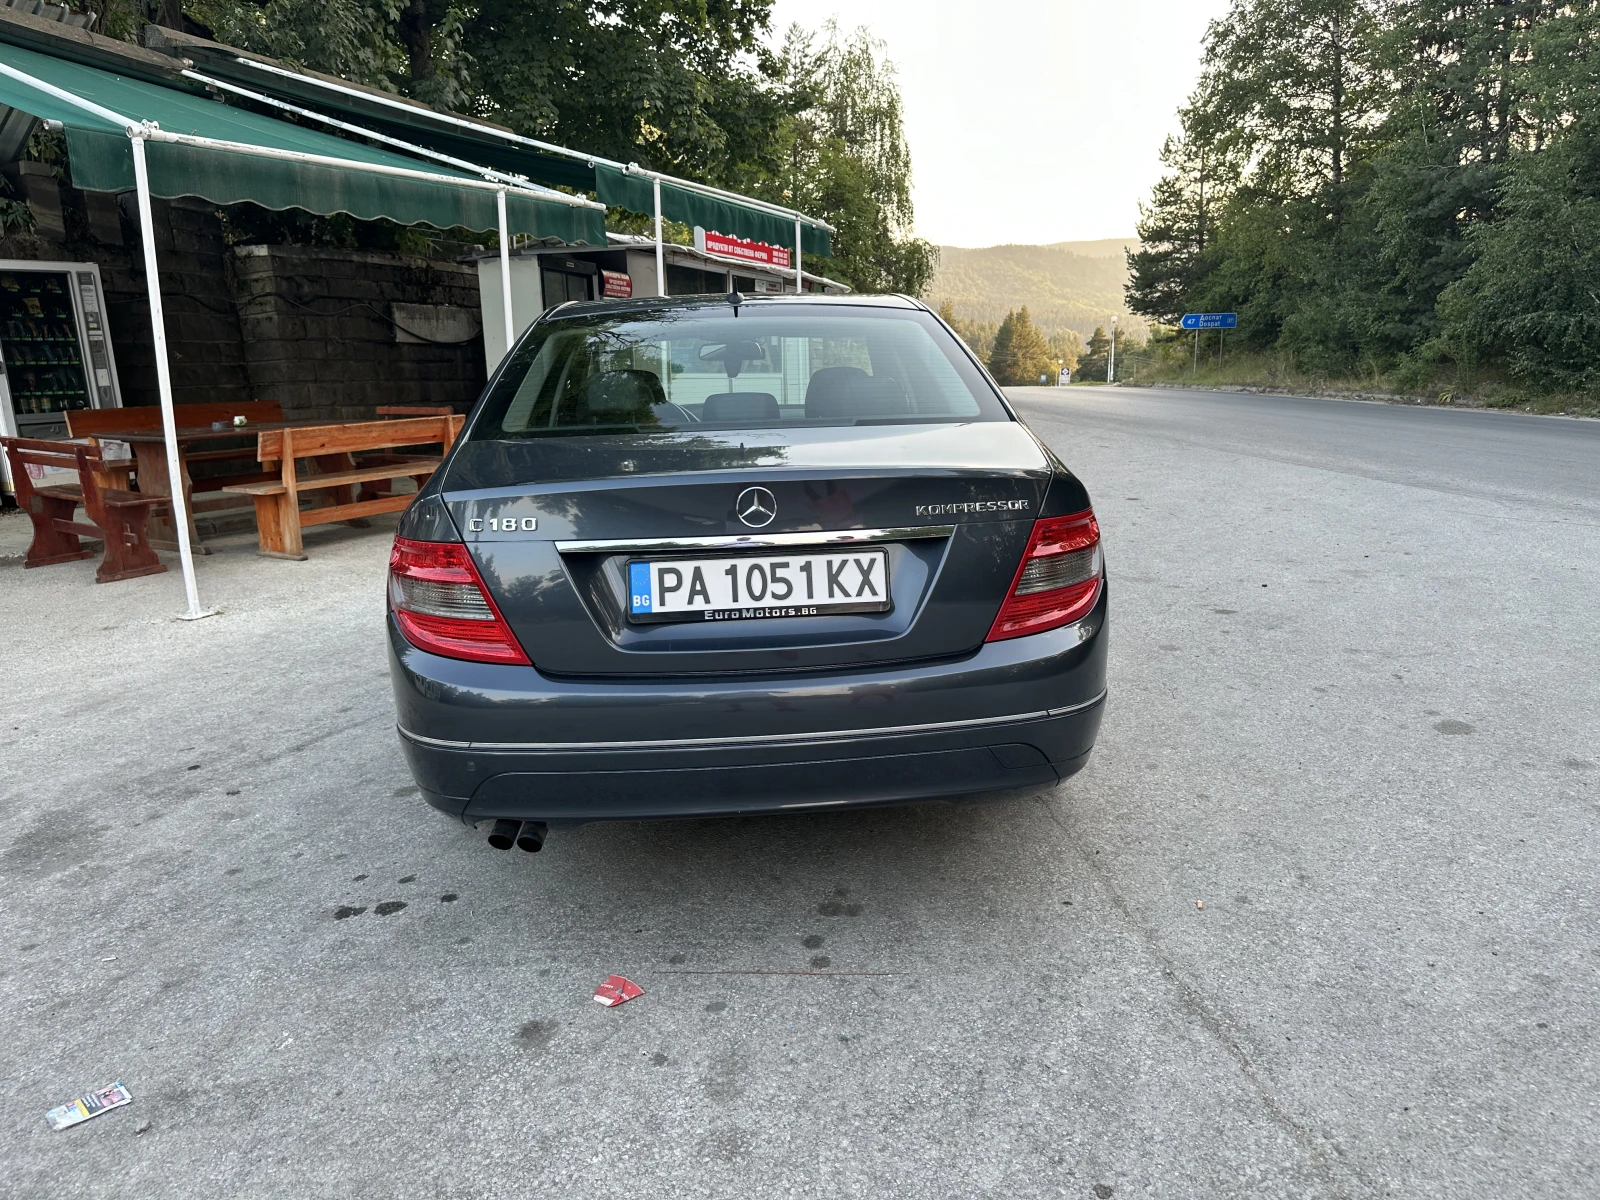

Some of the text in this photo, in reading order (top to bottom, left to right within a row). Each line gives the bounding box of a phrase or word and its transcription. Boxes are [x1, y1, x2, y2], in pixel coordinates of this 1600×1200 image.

[915, 499, 1030, 516] KOMPRESSOR
[469, 517, 538, 532] C 180
[633, 594, 650, 607] BG
